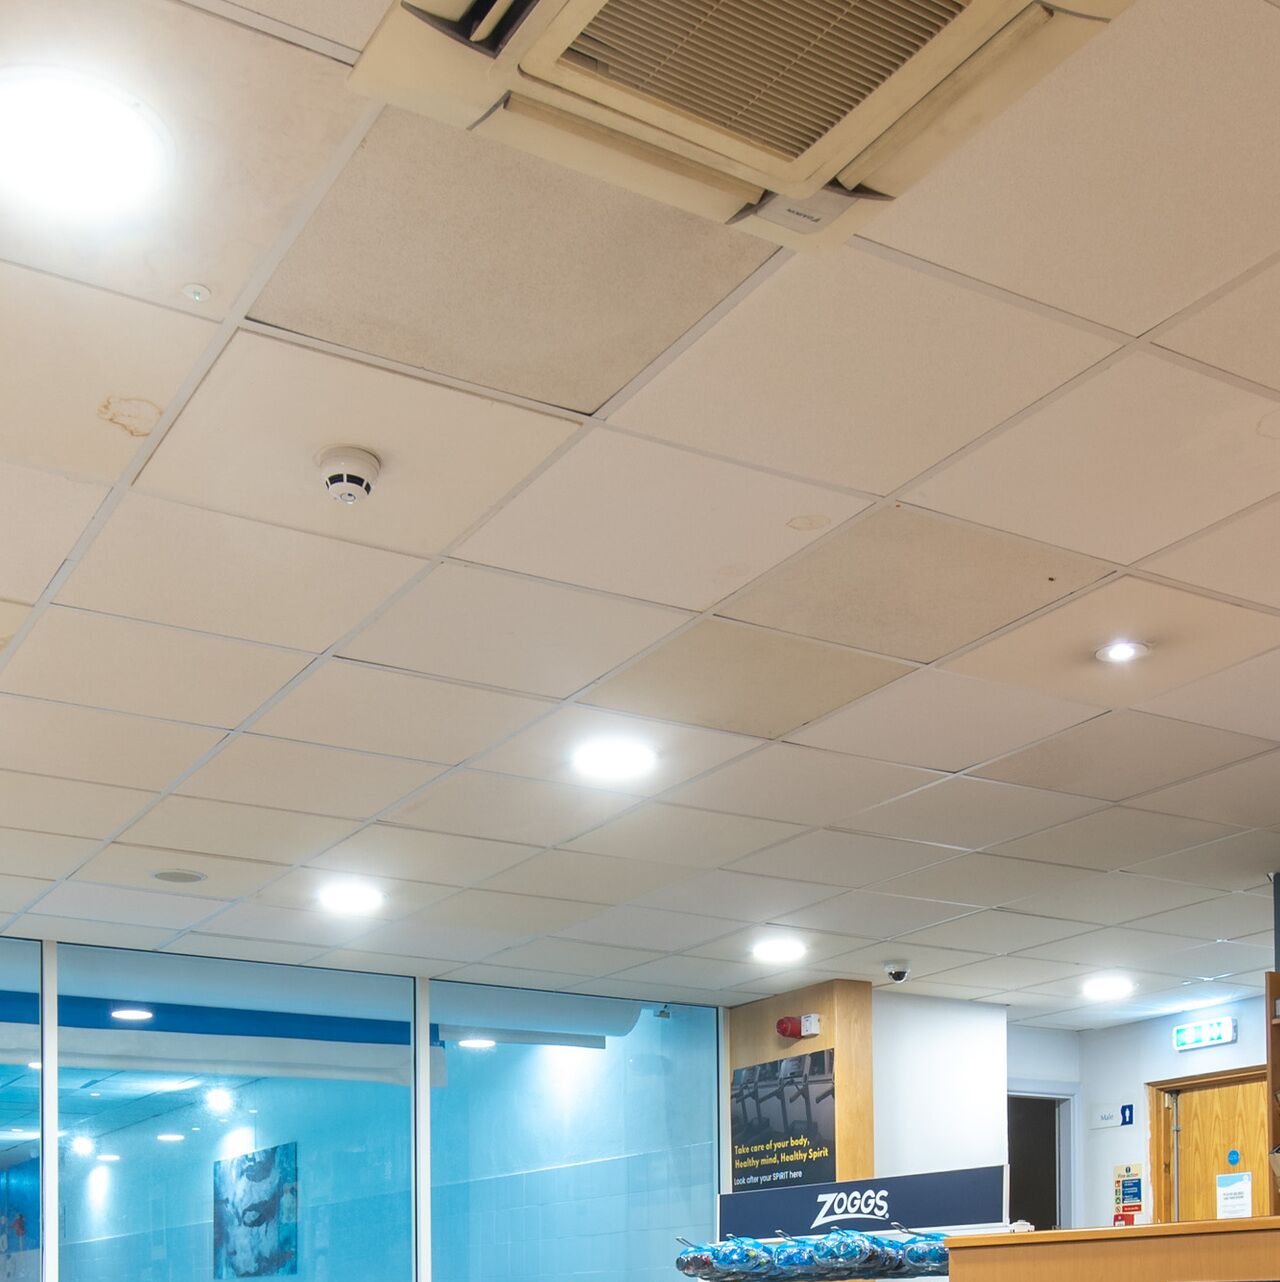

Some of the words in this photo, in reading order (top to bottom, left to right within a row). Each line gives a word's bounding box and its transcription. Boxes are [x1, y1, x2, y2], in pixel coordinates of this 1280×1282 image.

[734, 1145, 749, 1155] Take
[750, 1144, 765, 1152] care
[765, 1140, 773, 1150] of
[773, 1140, 789, 1151] your
[790, 1134, 810, 1147] body,
[735, 1156, 759, 1169] Healthy
[760, 1154, 780, 1165] mind,
[780, 1150, 807, 1162] Healthy
[808, 1147, 829, 1160] Spirit
[734, 1177, 745, 1186] Look
[746, 1175, 759, 1183] after
[759, 1174, 772, 1184] your
[772, 1171, 788, 1181] SPIRIT
[789, 1170, 803, 1178] here
[810, 1189, 890, 1229] ZOGGS
